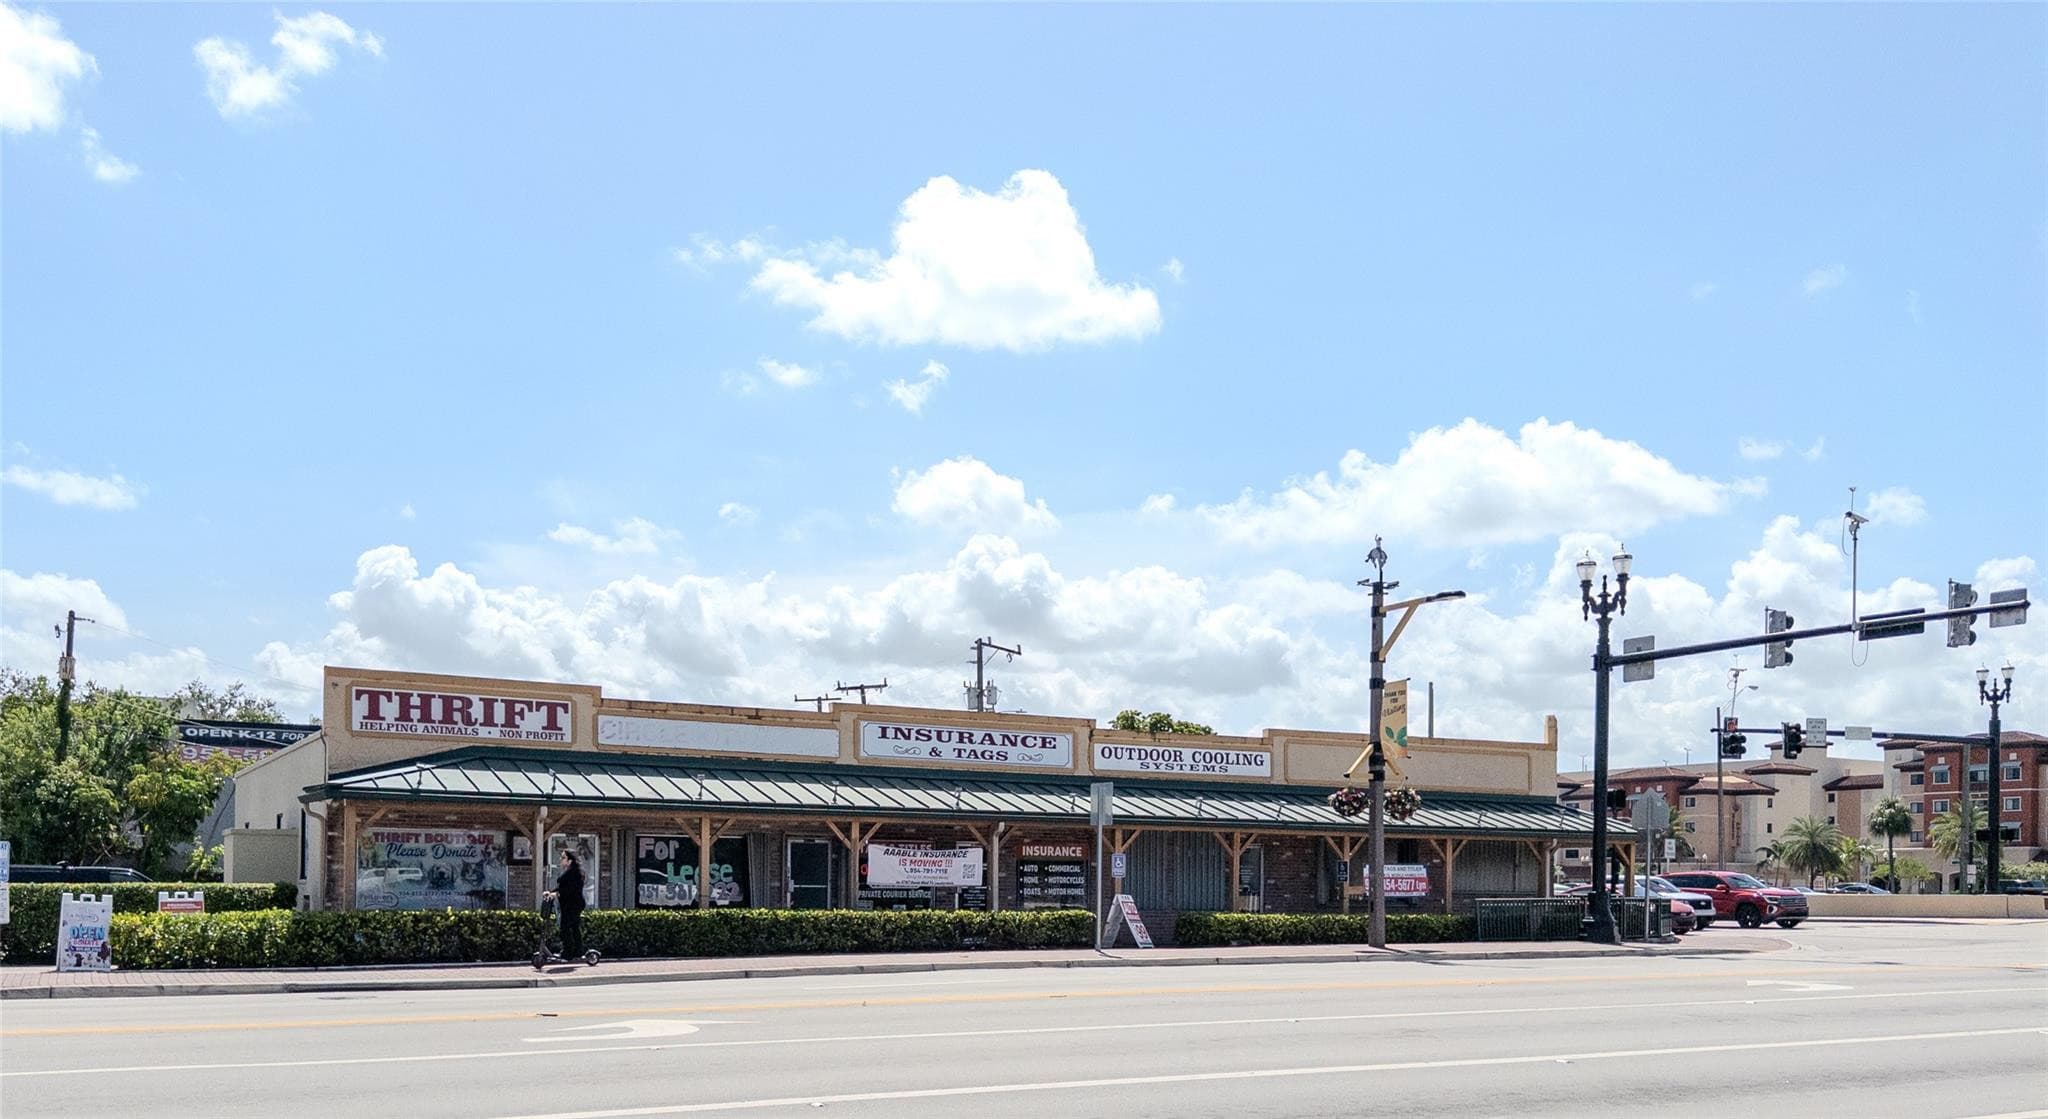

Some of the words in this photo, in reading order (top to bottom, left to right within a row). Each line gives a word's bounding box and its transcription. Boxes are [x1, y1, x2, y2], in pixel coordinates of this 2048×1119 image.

[355, 689, 569, 731] THRIFT
[185, 727, 233, 738] OPEN
[238, 730, 277, 740] K-12
[281, 732, 305, 741] FOR
[359, 721, 418, 733] HELPING
[422, 725, 479, 736] ANIMALS
[499, 729, 523, 738] NON
[525, 730, 566, 741] PROFIT
[877, 725, 1057, 750] INSURANCE
[928, 746, 942, 758] &
[953, 747, 1009, 761] TAGS
[1100, 745, 1184, 763] OUTDOOR
[1192, 750, 1265, 767] COOLING
[1140, 761, 1229, 773] SYSTEMS
[372, 831, 422, 843] THRIFT
[424, 832, 495, 845] BOUTIQUE
[385, 842, 427, 860] Please
[431, 843, 479, 860] Donate
[639, 837, 680, 860] For
[920, 849, 969, 859] INSURANCE
[1022, 845, 1082, 857] INSURANCE
[899, 858, 907, 867] IS
[909, 859, 943, 868] MOVING
[1024, 864, 1039, 872] AUTO
[1048, 864, 1080, 872] COMMERCIAL
[666, 861, 734, 884] Lese
[1048, 876, 1085, 884] MOTORCYCLES
[882, 890, 908, 899] COURIER
[909, 890, 932, 899] SERVICE
[1024, 887, 1041, 895] BOATS
[1048, 887, 1066, 895] MOTOR
[1067, 887, 1085, 895] HOMES
[70, 926, 105, 940] OPEN
